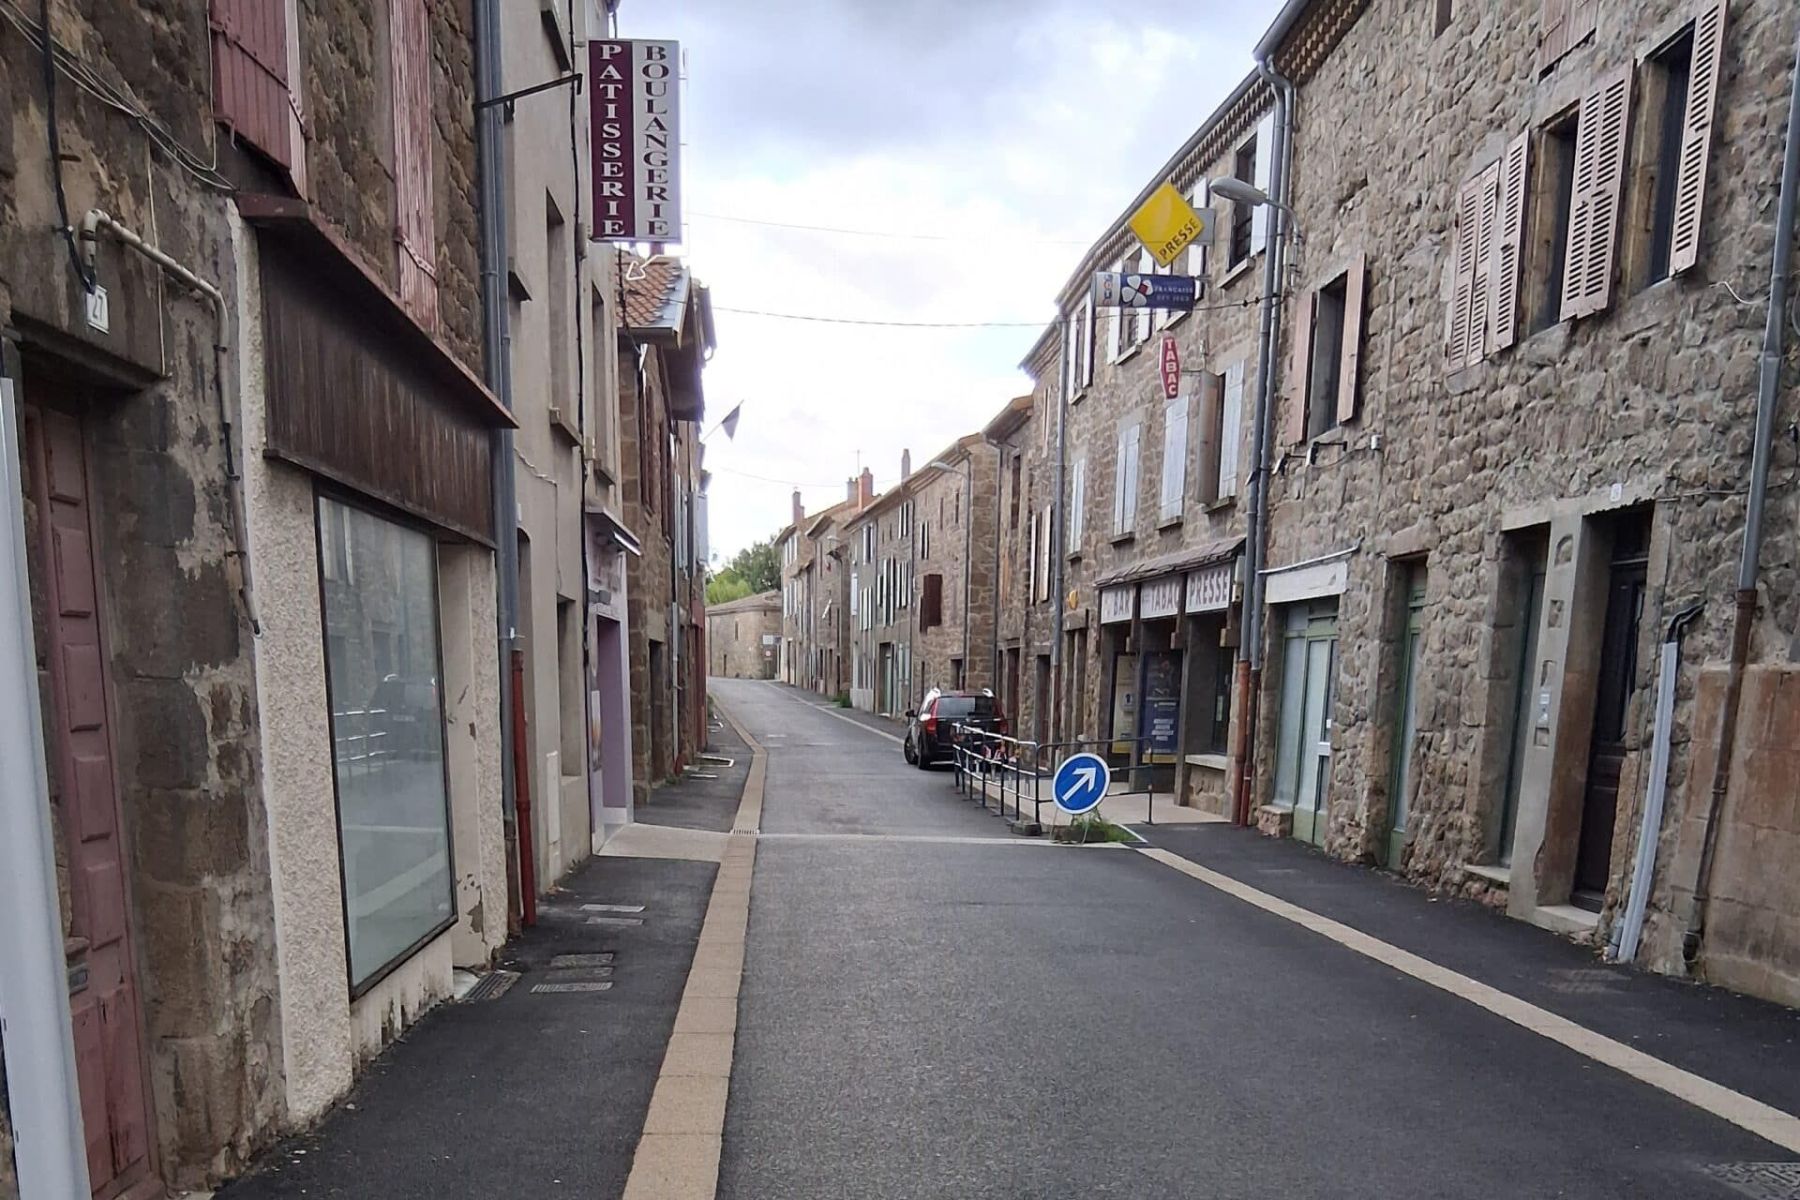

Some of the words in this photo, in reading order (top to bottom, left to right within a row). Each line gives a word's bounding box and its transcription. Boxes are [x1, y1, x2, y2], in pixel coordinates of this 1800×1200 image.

[599, 44, 626, 236] PATISSERIE
[641, 45, 670, 236] BOULANGERIE
[1158, 217, 1199, 260] PRESSE
[1165, 338, 1177, 395] TABAC
[1113, 589, 1130, 616] BAR
[1189, 568, 1228, 606] PRESSE
